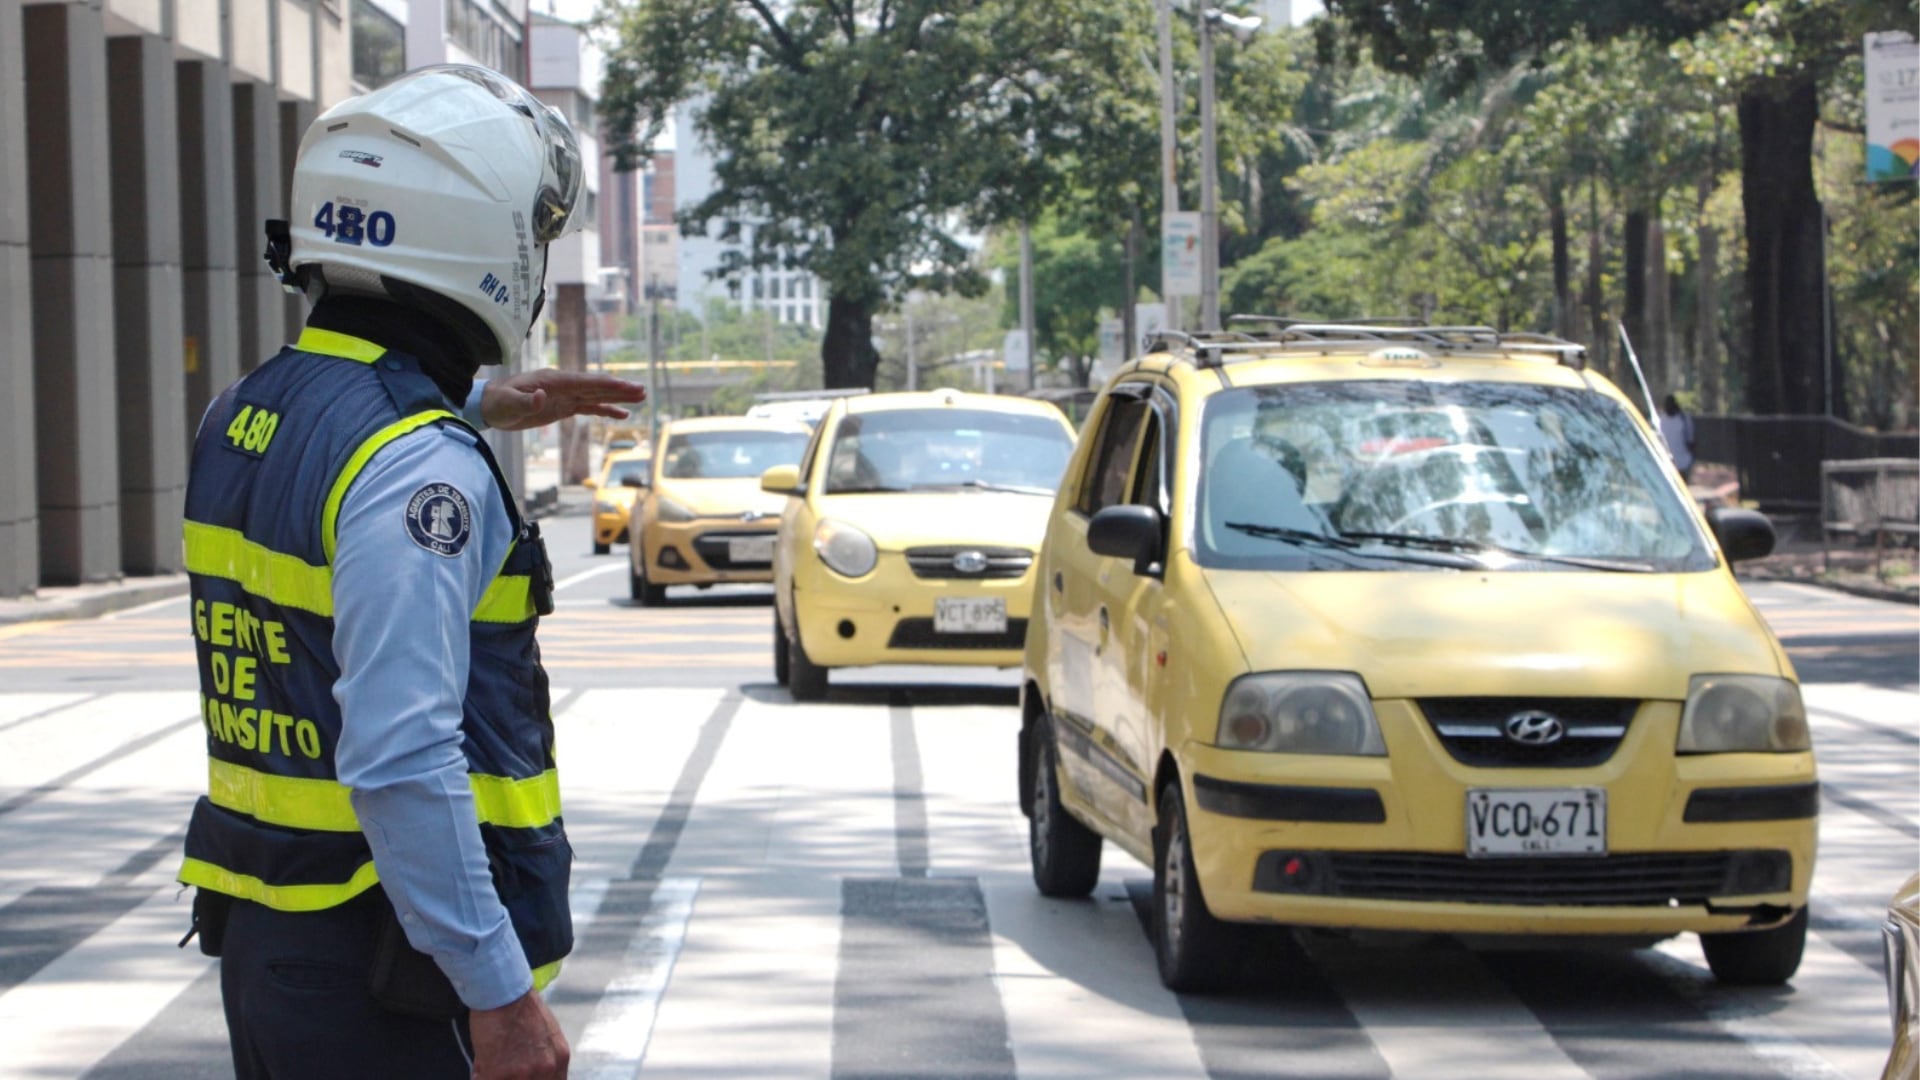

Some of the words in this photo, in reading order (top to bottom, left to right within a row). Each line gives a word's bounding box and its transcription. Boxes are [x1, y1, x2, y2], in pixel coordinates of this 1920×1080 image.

[314, 201, 396, 247] 480
[512, 210, 530, 310] SHAFT
[479, 272, 500, 297] RH
[226, 405, 279, 454] 480
[408, 486, 435, 520] AGENTES
[437, 485, 450, 495] DE
[451, 489, 470, 532] TRANSITO
[430, 541, 452, 553] CALI
[195, 599, 291, 664] GENTE
[211, 652, 257, 700] DE
[1541, 801, 1599, 837] 671
